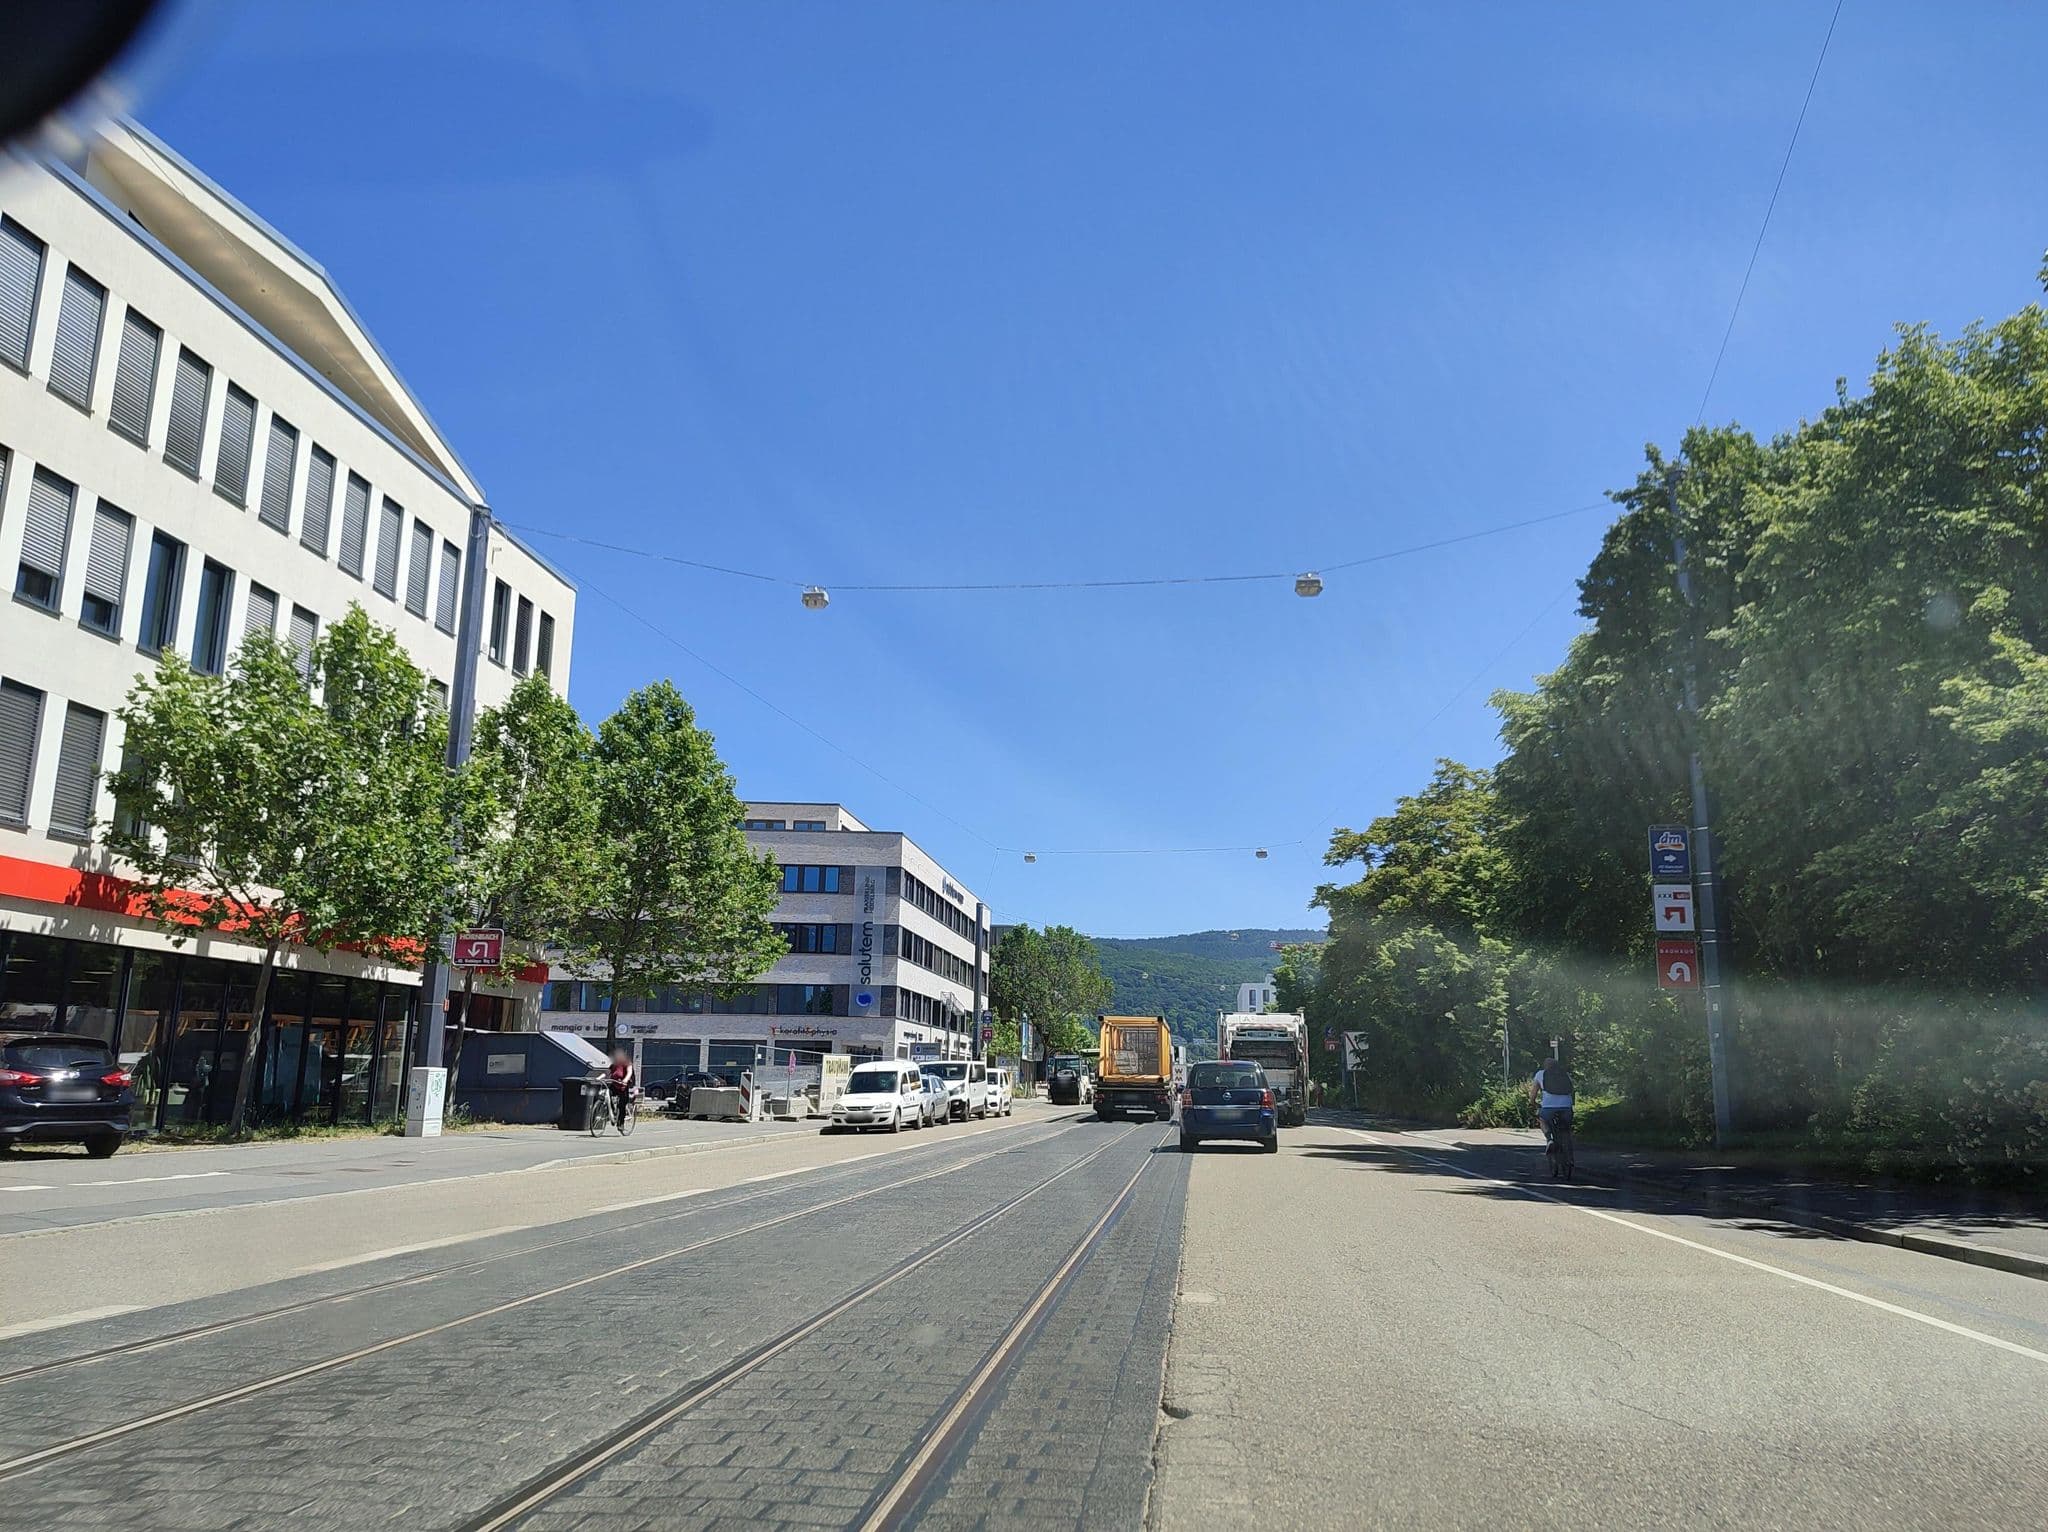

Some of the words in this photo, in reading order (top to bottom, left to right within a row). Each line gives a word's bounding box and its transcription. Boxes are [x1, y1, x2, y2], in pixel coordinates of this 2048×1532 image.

[1660, 832, 1680, 843] dm
[857, 921, 873, 985] salutem
[551, 1023, 582, 1033] mangia
